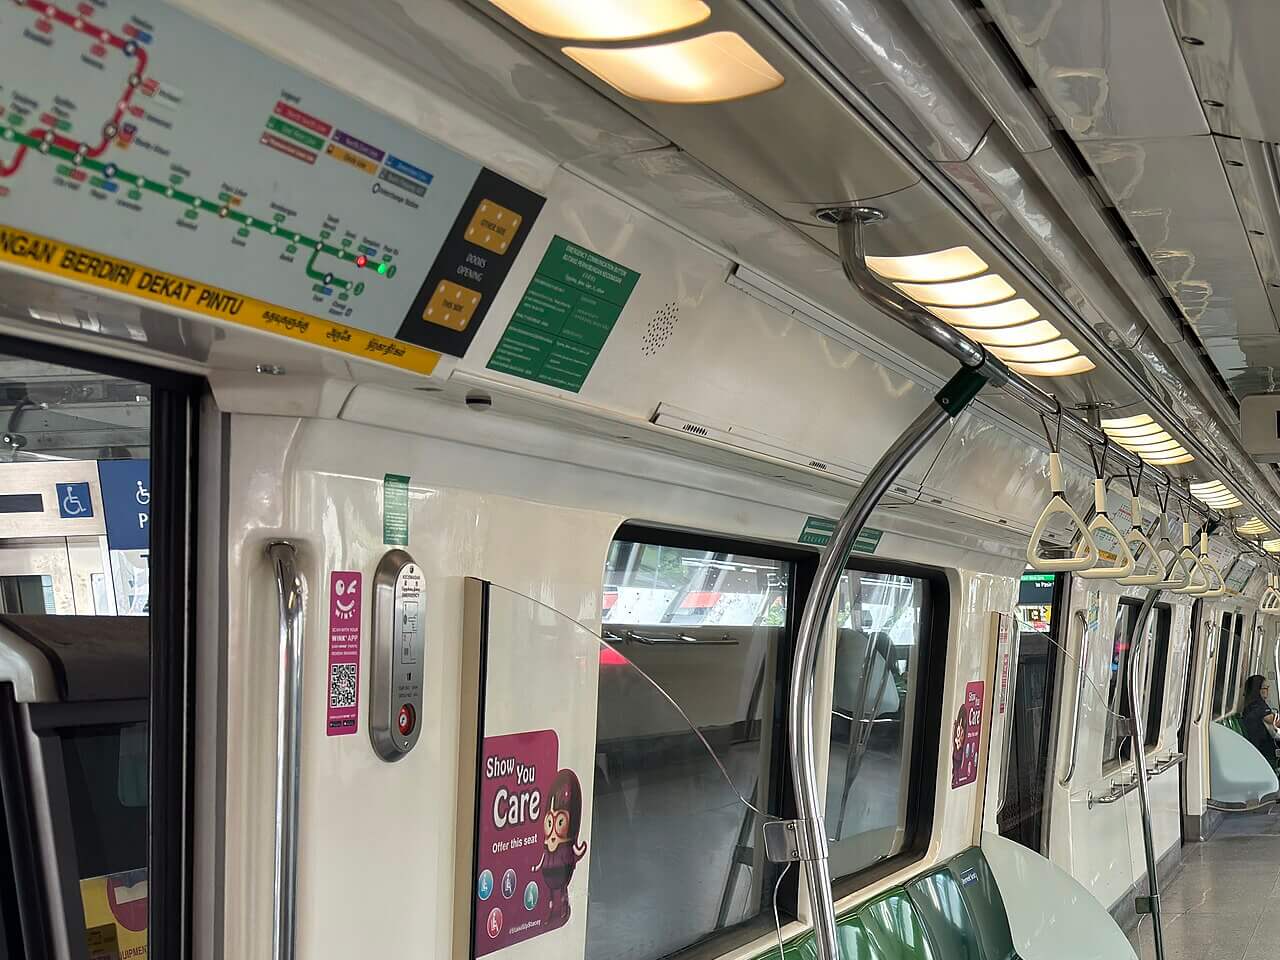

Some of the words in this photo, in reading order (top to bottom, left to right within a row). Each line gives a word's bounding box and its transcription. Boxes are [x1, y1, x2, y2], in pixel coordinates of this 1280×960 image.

[60, 250, 138, 286] BERDIRI
[137, 271, 197, 303] DEKAT
[197, 290, 245, 316] PINTU
[456, 265, 484, 283] OPENING
[486, 757, 515, 778] Show
[516, 764, 535, 785] You
[493, 789, 541, 829] Care
[492, 840, 510, 854] Offer
[510, 836, 523, 849] this
[523, 833, 538, 847] seat
